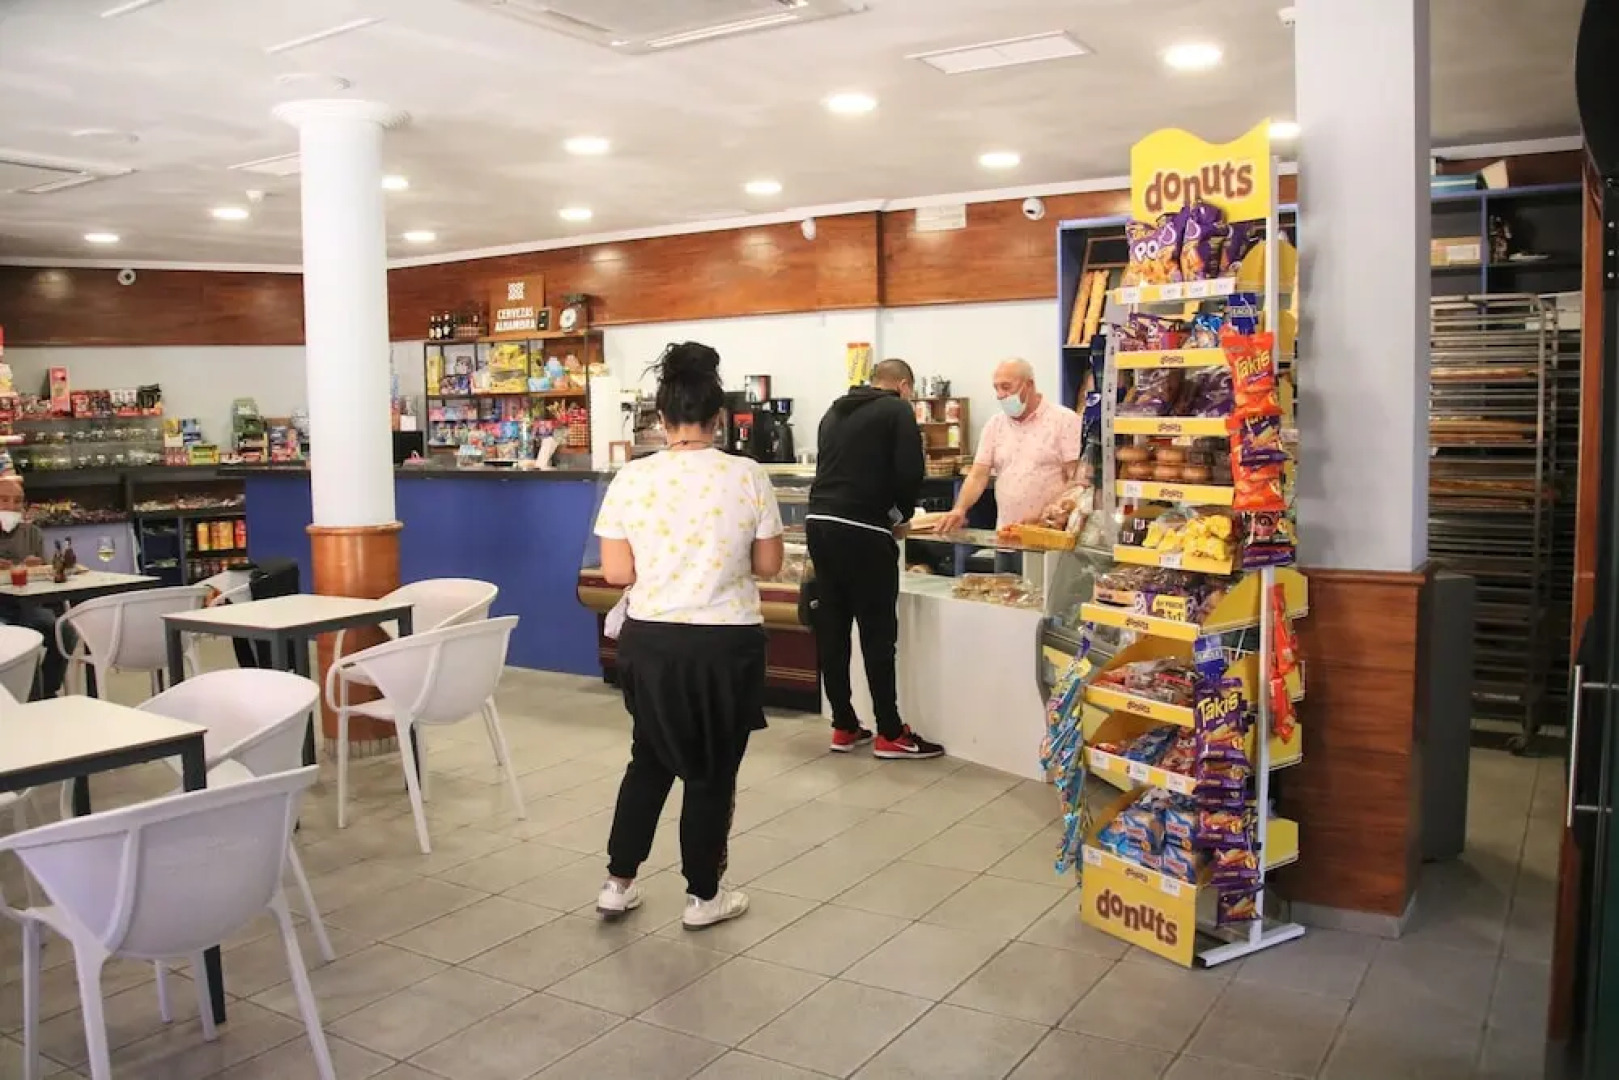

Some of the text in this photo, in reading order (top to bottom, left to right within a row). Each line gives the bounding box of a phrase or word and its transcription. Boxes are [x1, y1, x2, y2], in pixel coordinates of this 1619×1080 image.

[1145, 162, 1253, 213] donuts
[1234, 350, 1270, 385] Takis
[1198, 691, 1239, 728] Takis
[1096, 889, 1178, 944] donuts
